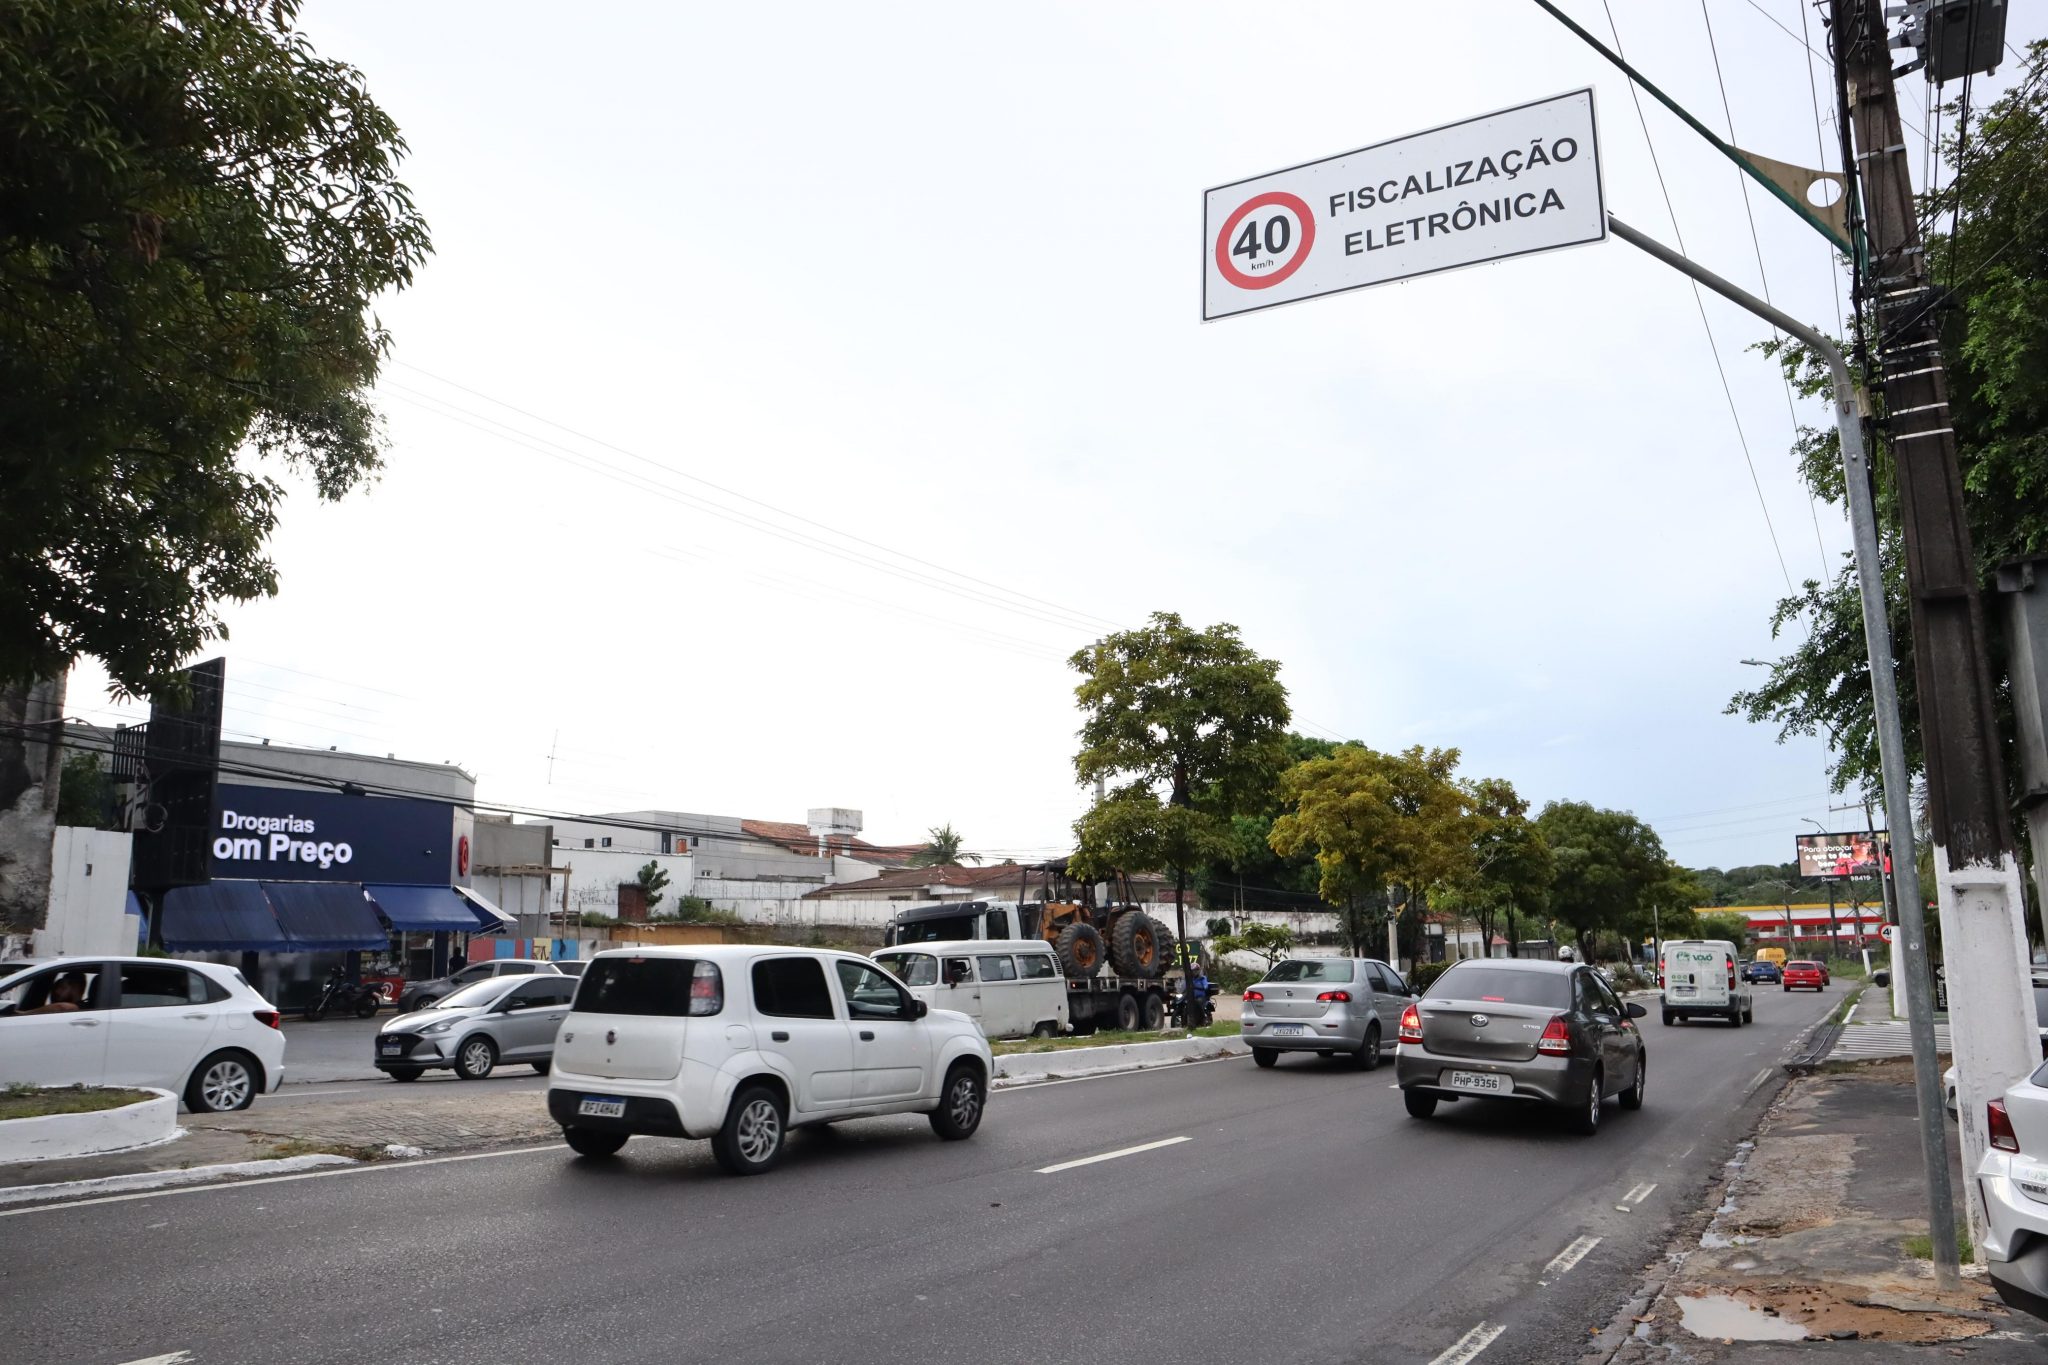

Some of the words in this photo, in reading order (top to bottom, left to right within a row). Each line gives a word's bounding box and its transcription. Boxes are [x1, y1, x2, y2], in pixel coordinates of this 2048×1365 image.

[1329, 137, 1578, 217] FISCALIZAÇÃO
[1232, 214, 1291, 260] 40
[1344, 188, 1565, 256] ELETRÔNICA
[1251, 259, 1274, 271] km/h
[222, 810, 315, 835] Drogarias
[213, 837, 262, 860] om
[268, 833, 353, 869] Preço
[1883, 928, 1892, 936] 4
